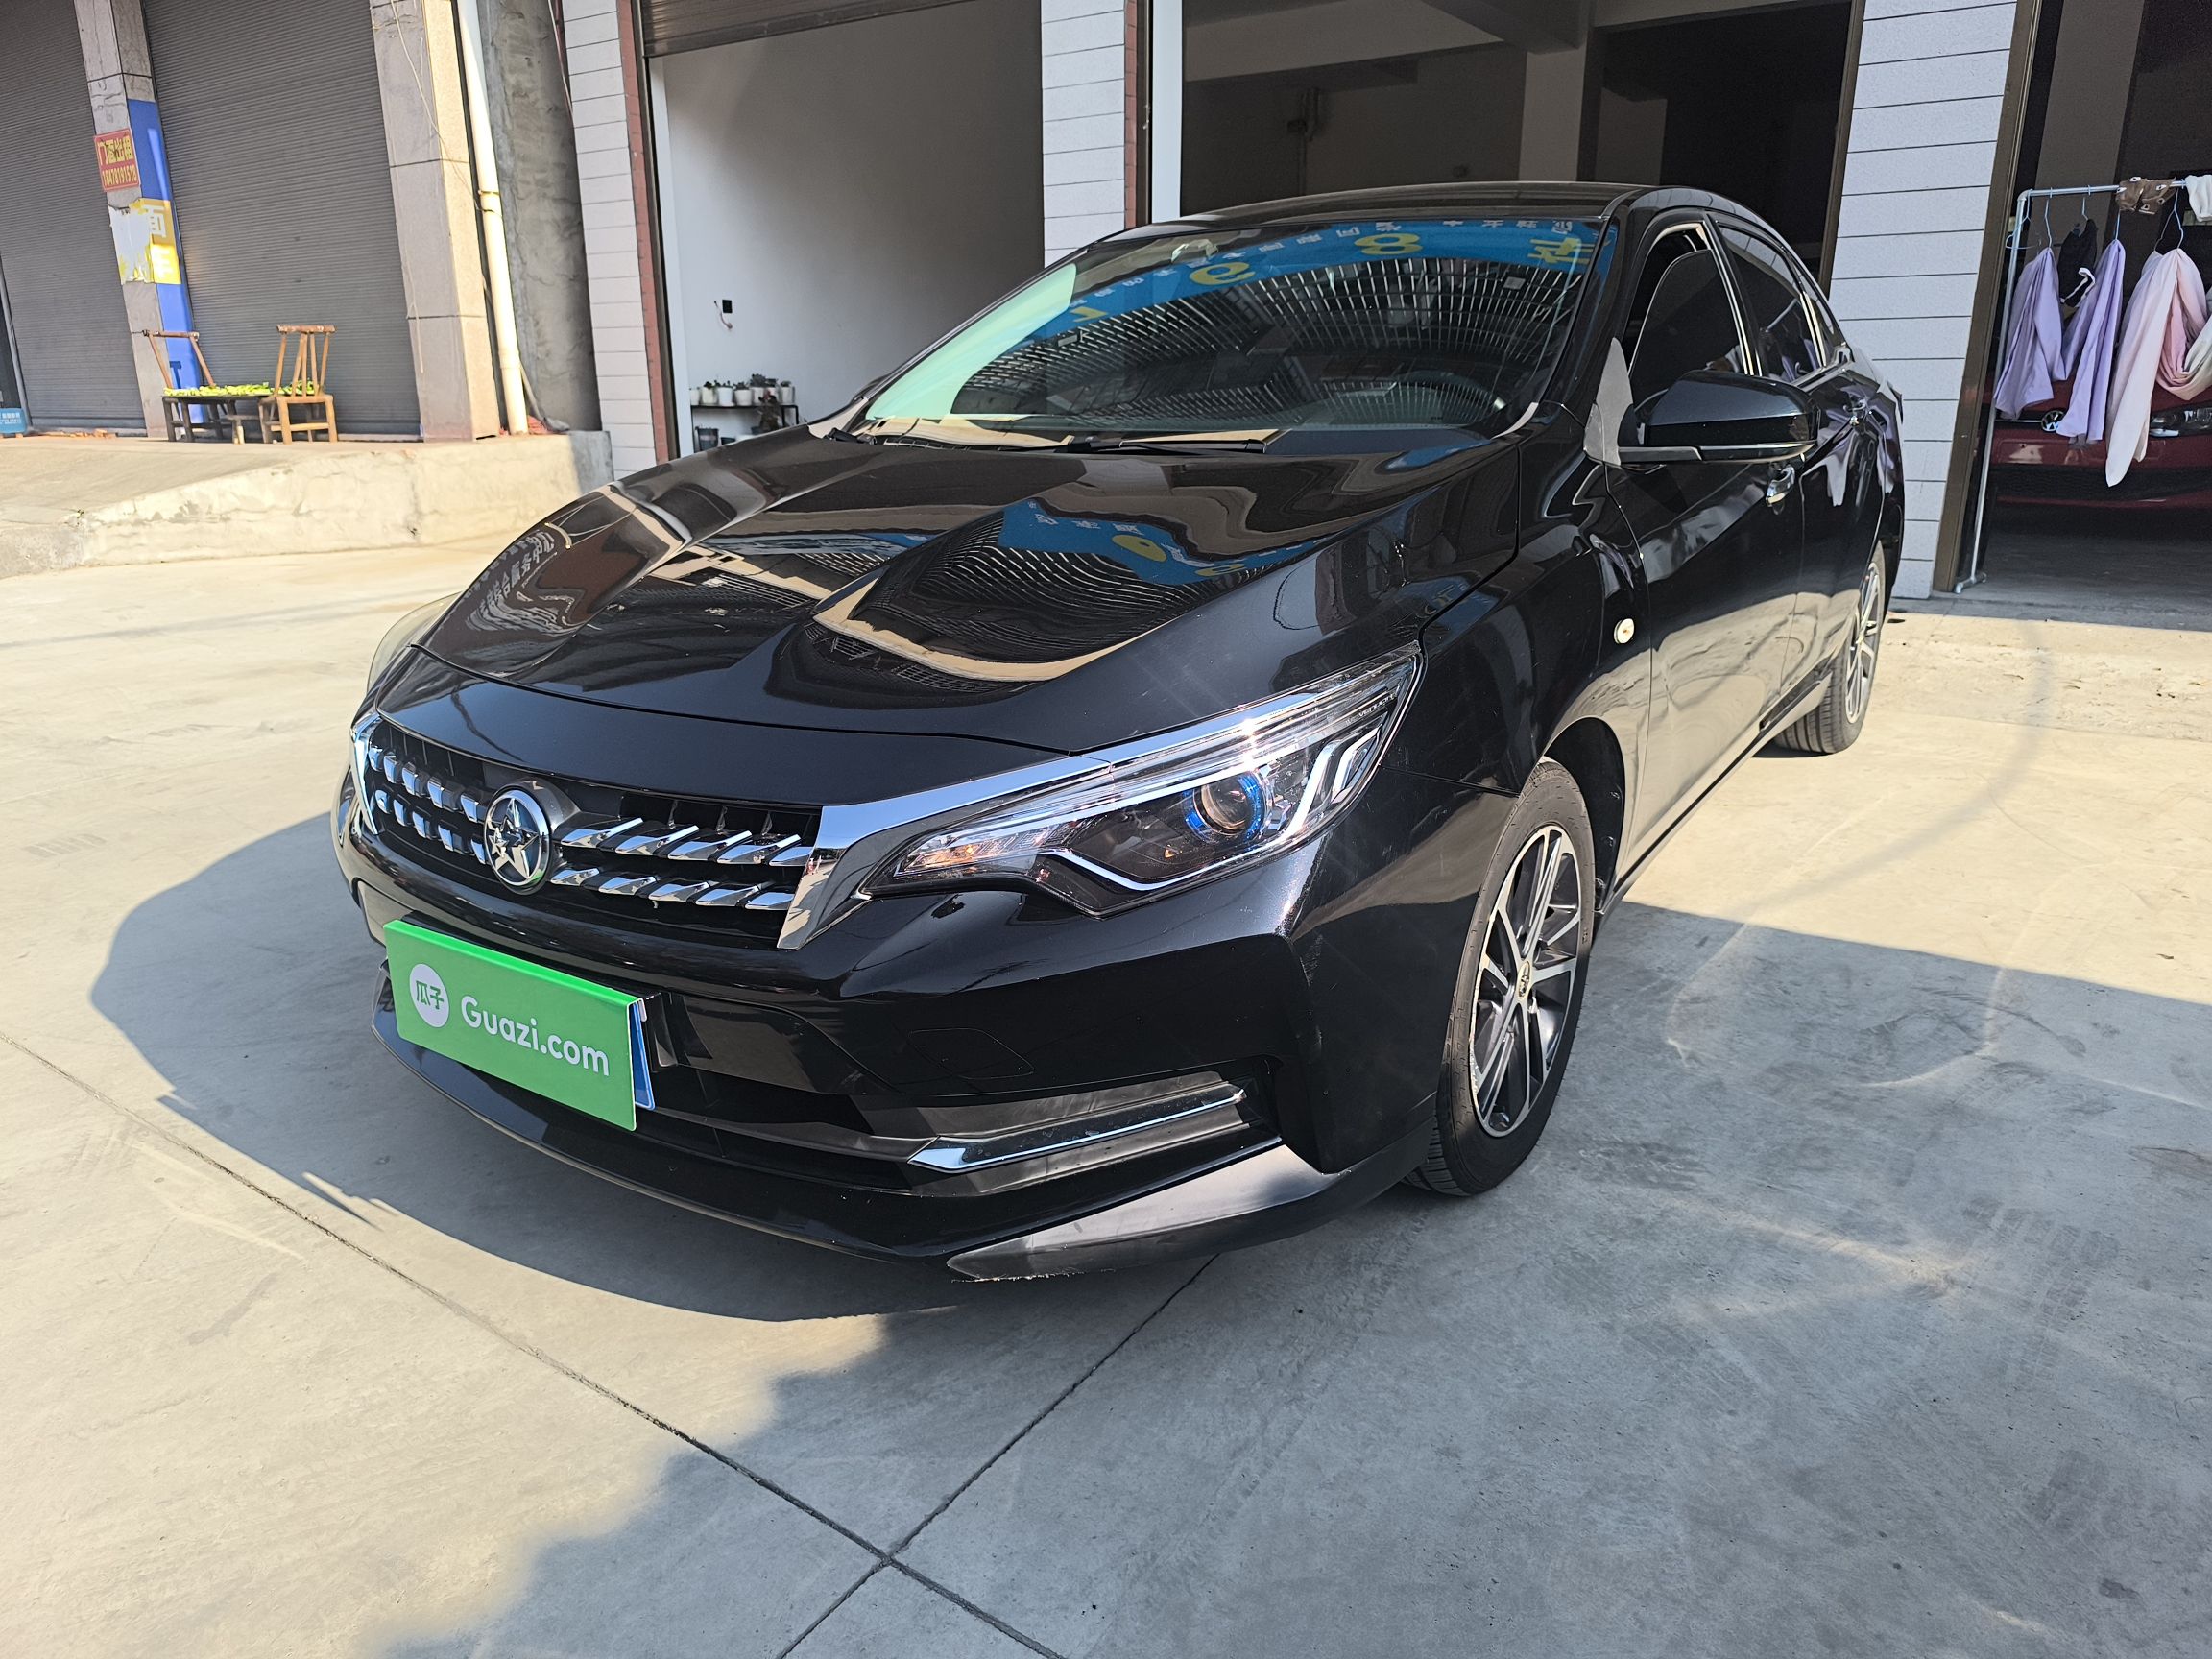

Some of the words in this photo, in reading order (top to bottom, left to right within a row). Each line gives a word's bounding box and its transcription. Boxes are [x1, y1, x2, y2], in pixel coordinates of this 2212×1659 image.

[97, 135, 134, 166] 门面出租
[415, 979, 445, 1011] 瓜子
[461, 996, 611, 1077] Guazi.com
